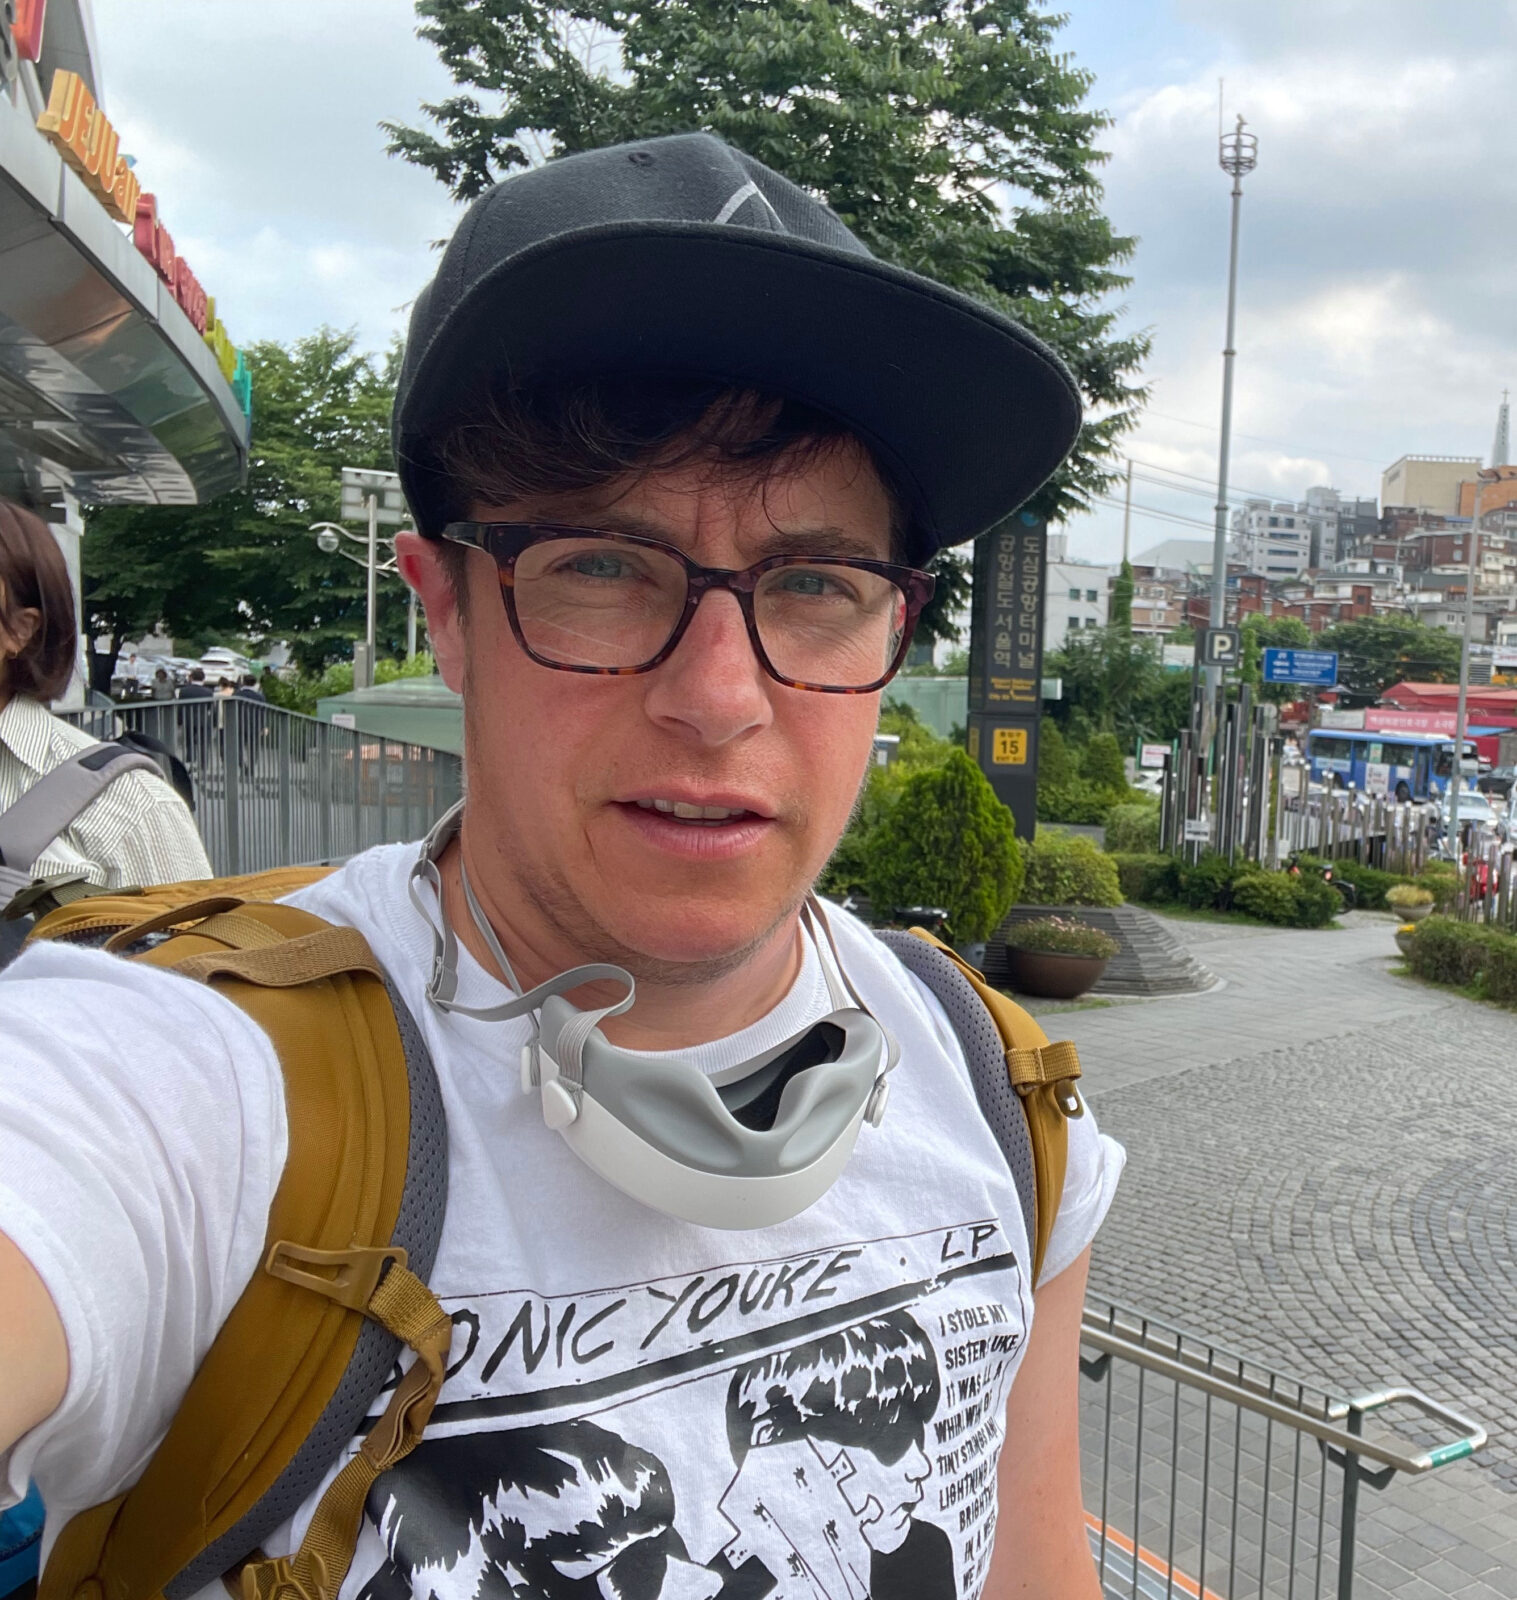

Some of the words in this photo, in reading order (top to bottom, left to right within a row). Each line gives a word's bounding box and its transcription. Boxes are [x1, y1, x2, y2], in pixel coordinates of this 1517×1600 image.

[996, 535, 1016, 609] 공항철도
[1017, 536, 1041, 670] 도심공항터미널
[993, 613, 1014, 670] 서울역
[1212, 633, 1233, 660] P
[1001, 740, 1019, 755] 15
[394, 1298, 627, 1391] ONIC
[640, 1248, 864, 1350] YOUKE
[941, 1223, 999, 1262] LP
[939, 1315, 946, 1338] I
[947, 1307, 989, 1334] STOLE
[986, 1304, 1009, 1324] MY
[958, 1373, 981, 1401] WAS
[936, 1449, 960, 1476] TINY
[939, 1460, 989, 1511] LIGHTNING
